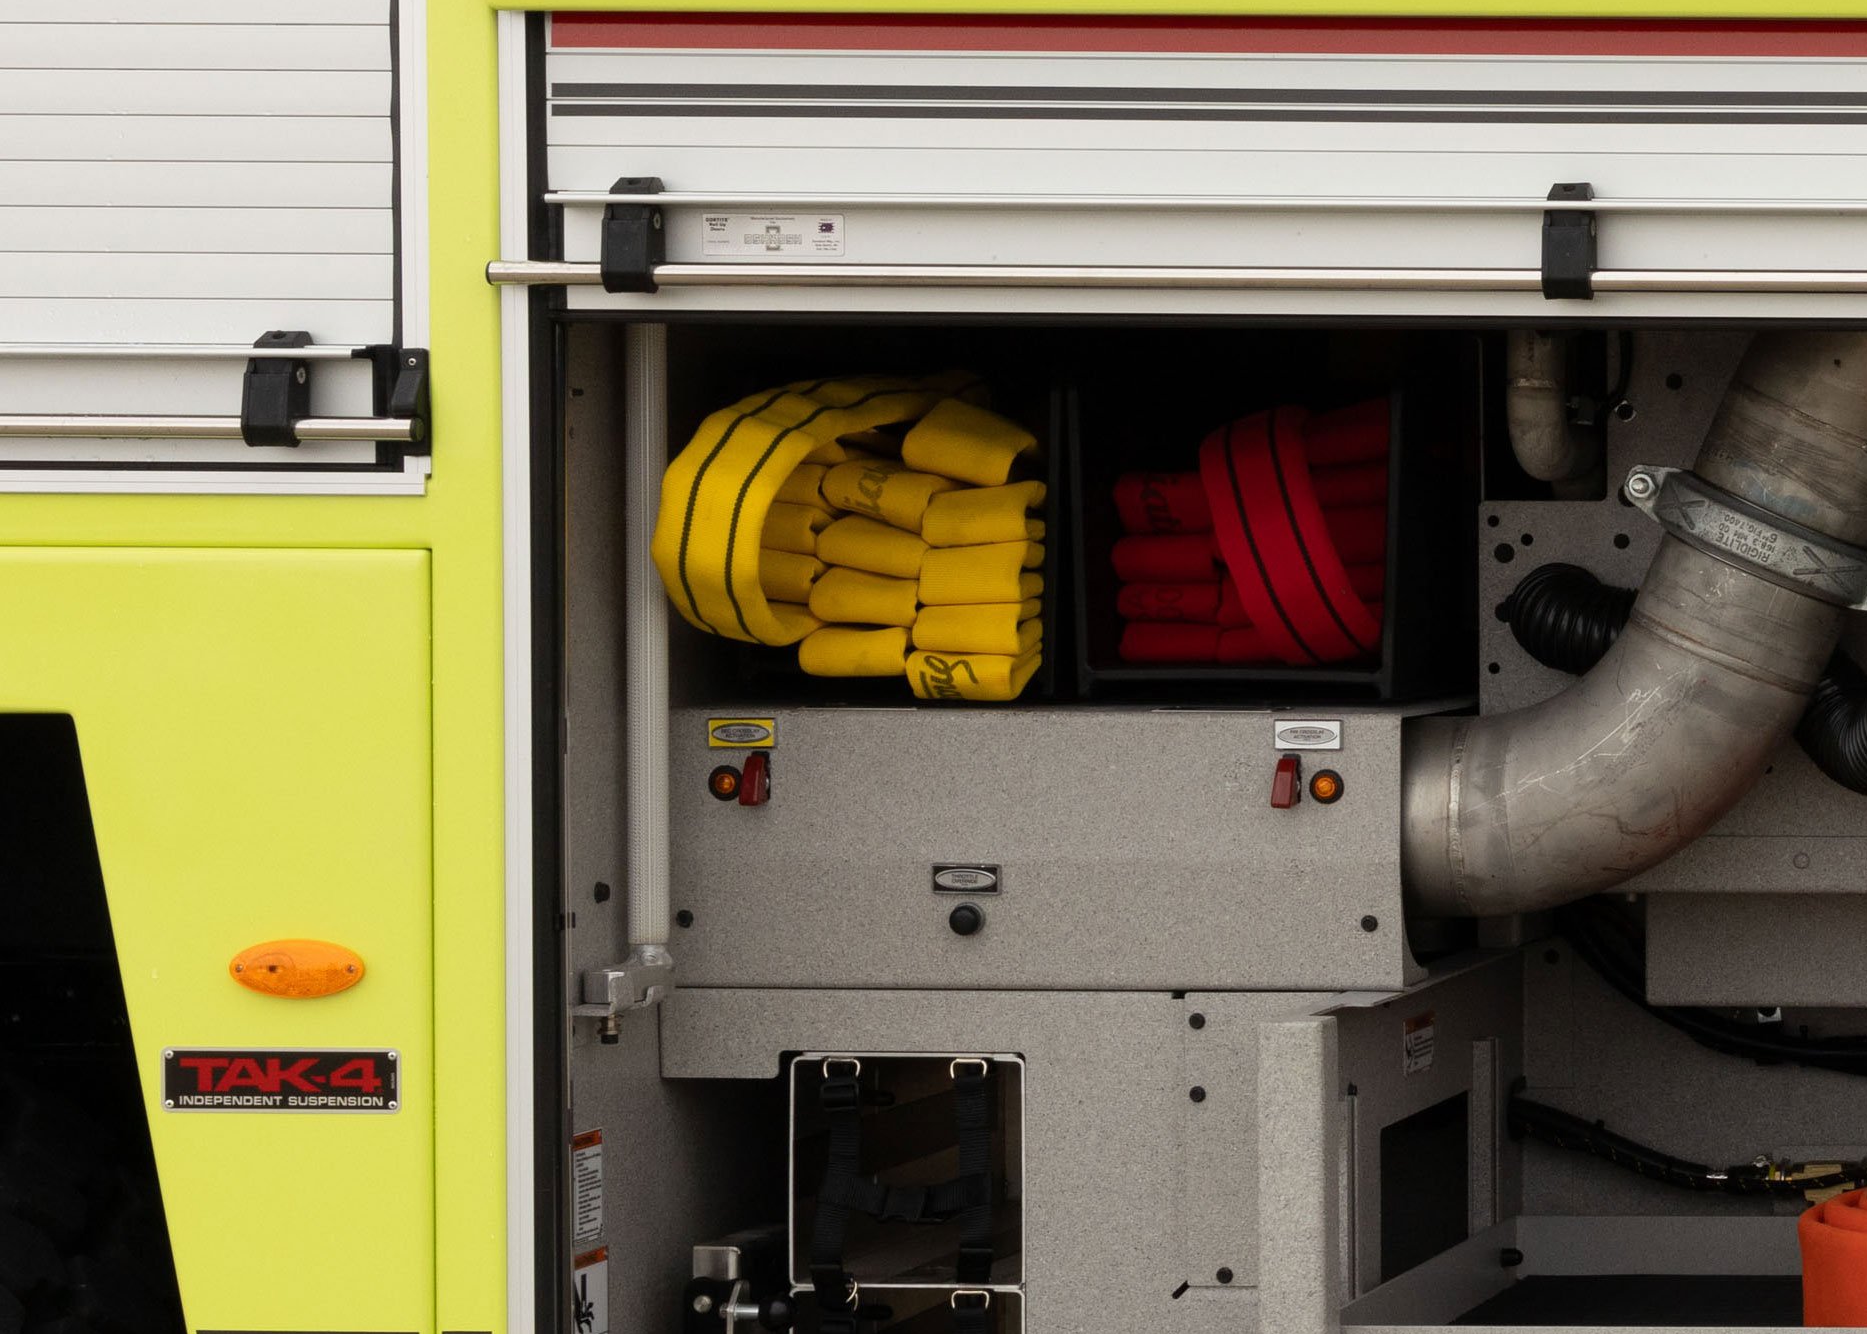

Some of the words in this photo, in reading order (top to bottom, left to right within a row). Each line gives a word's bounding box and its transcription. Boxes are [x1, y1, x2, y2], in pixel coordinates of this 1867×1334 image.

[1715, 532, 1771, 563] RIGIDLITE
[179, 1057, 383, 1093] TAK-4
[179, 1095, 283, 1106] INDEPENDENT
[288, 1096, 384, 1107] SUSPENSION
